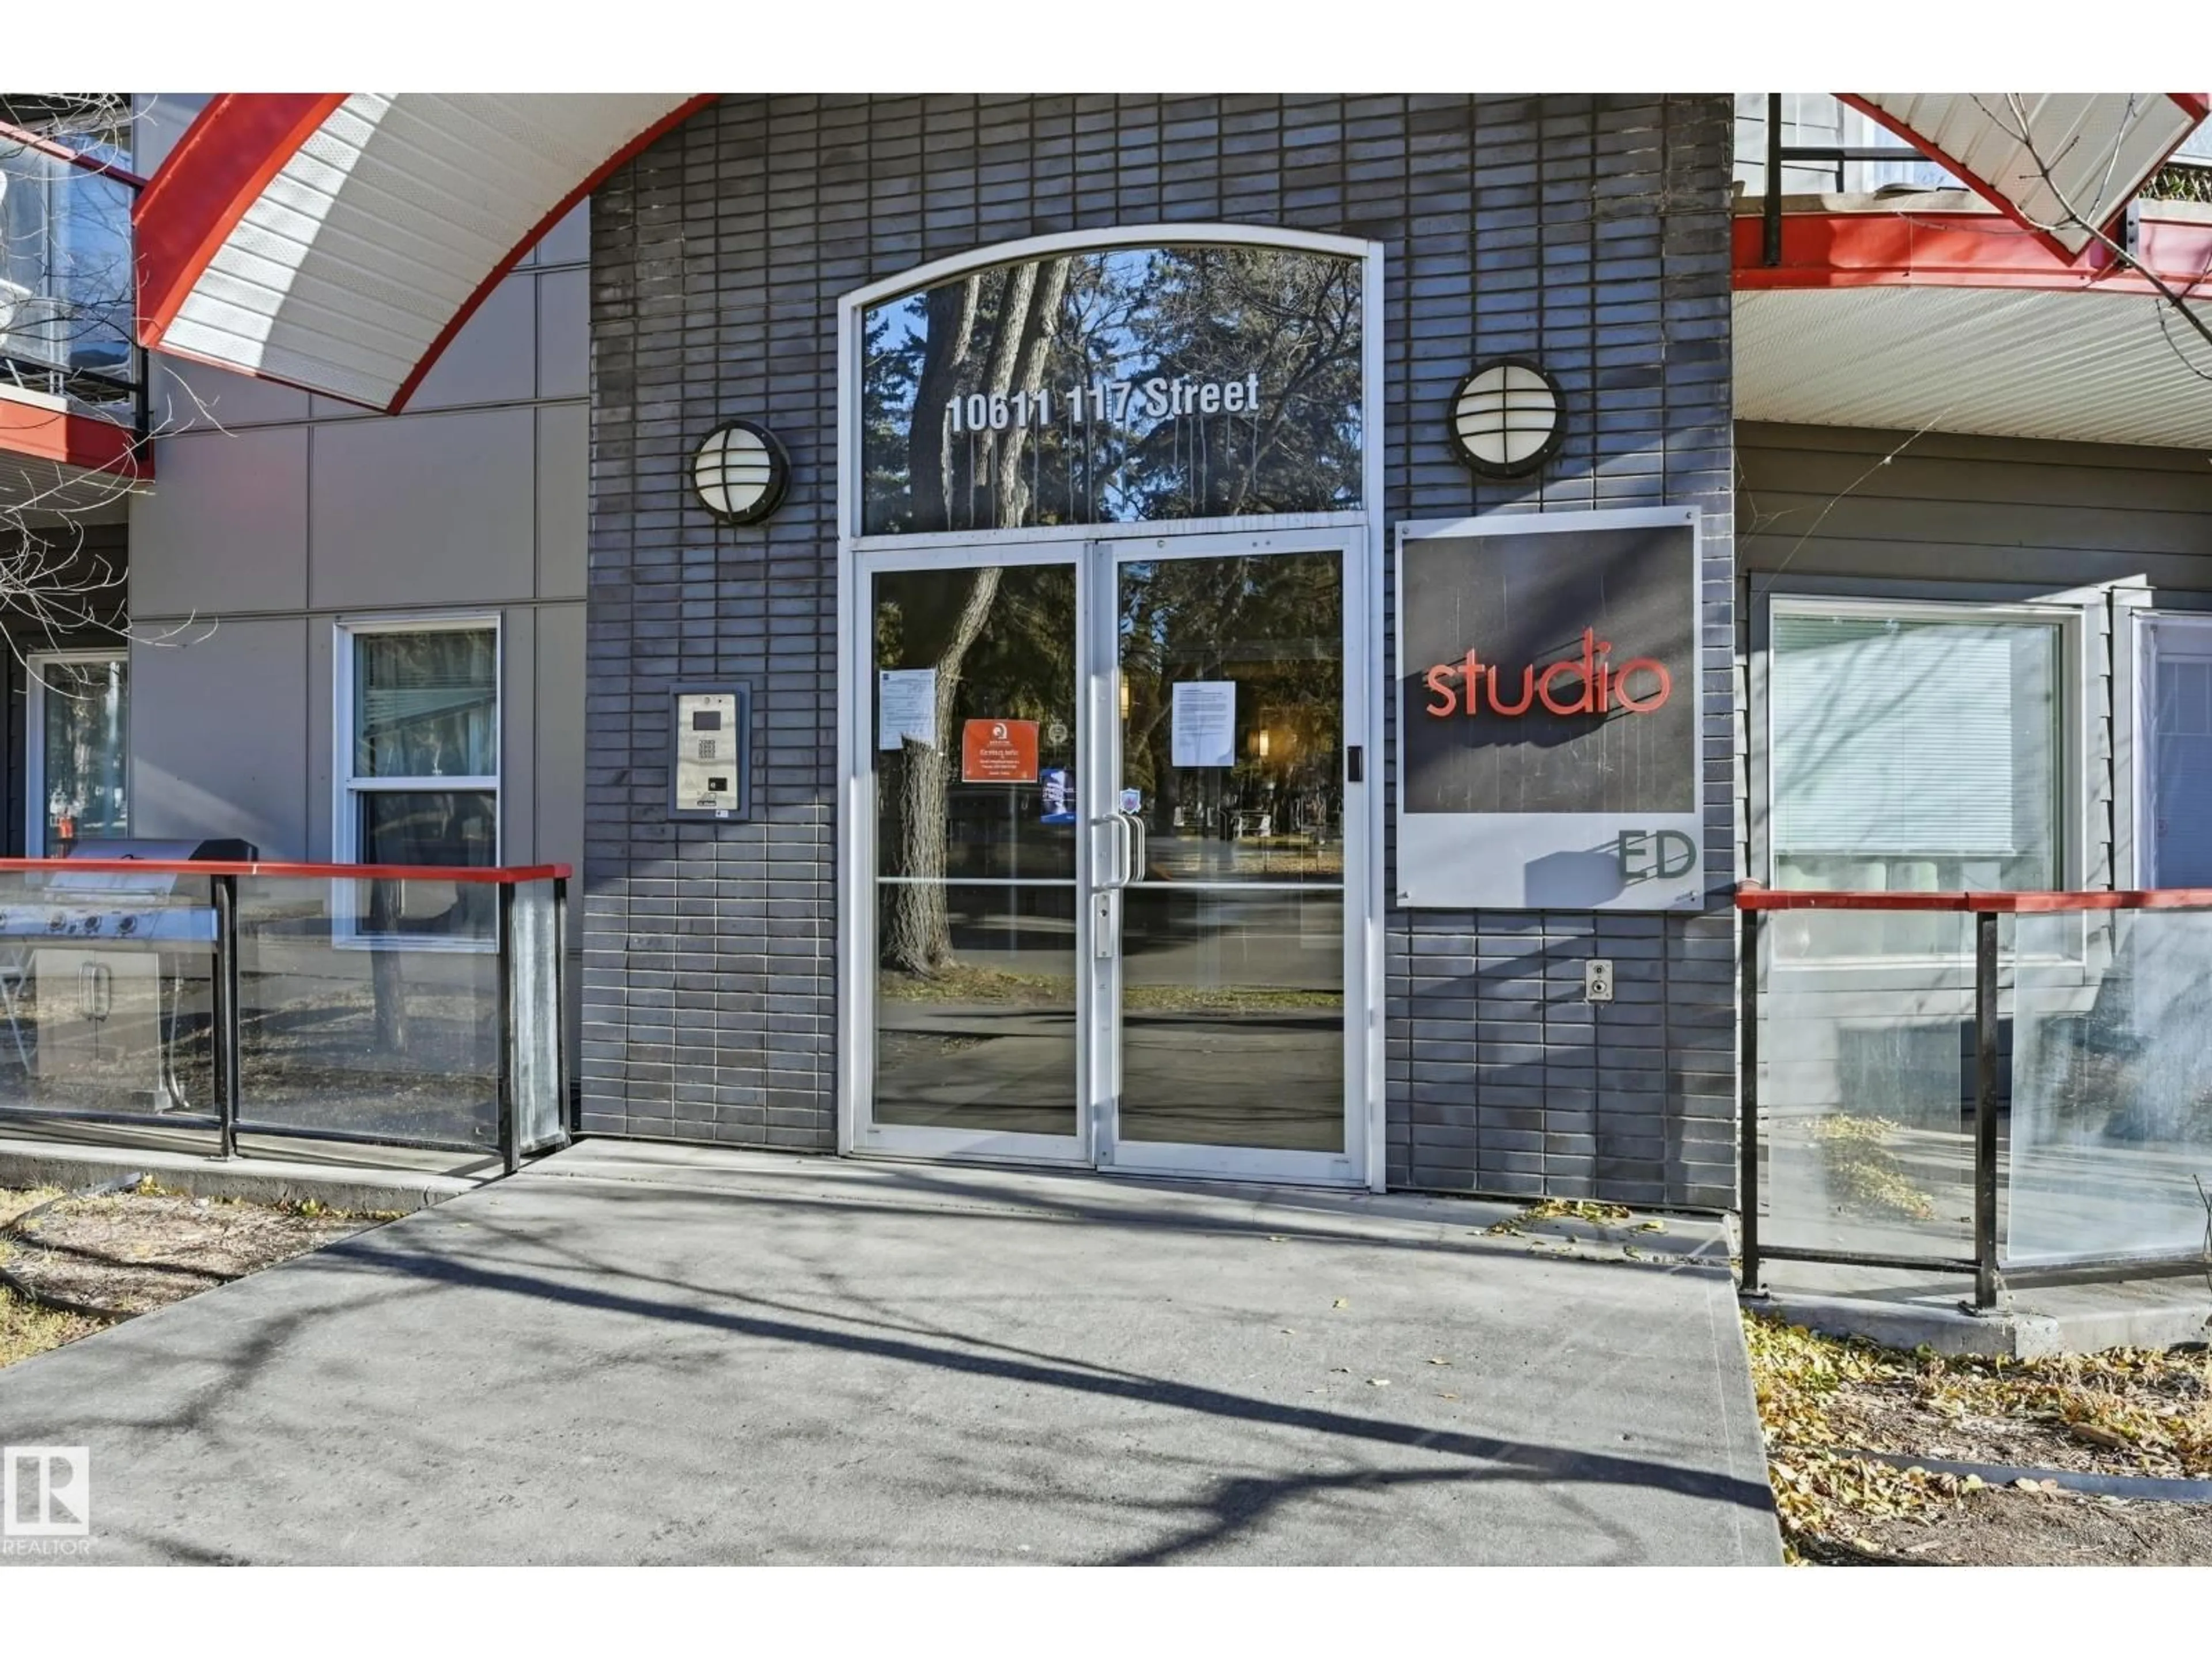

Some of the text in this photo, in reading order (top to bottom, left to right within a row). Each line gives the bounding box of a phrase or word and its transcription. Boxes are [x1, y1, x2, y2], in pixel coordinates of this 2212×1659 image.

[946, 372, 1259, 432] 10611 117 Street
[1426, 626, 1672, 717] studio
[1618, 829, 1698, 879] ED
